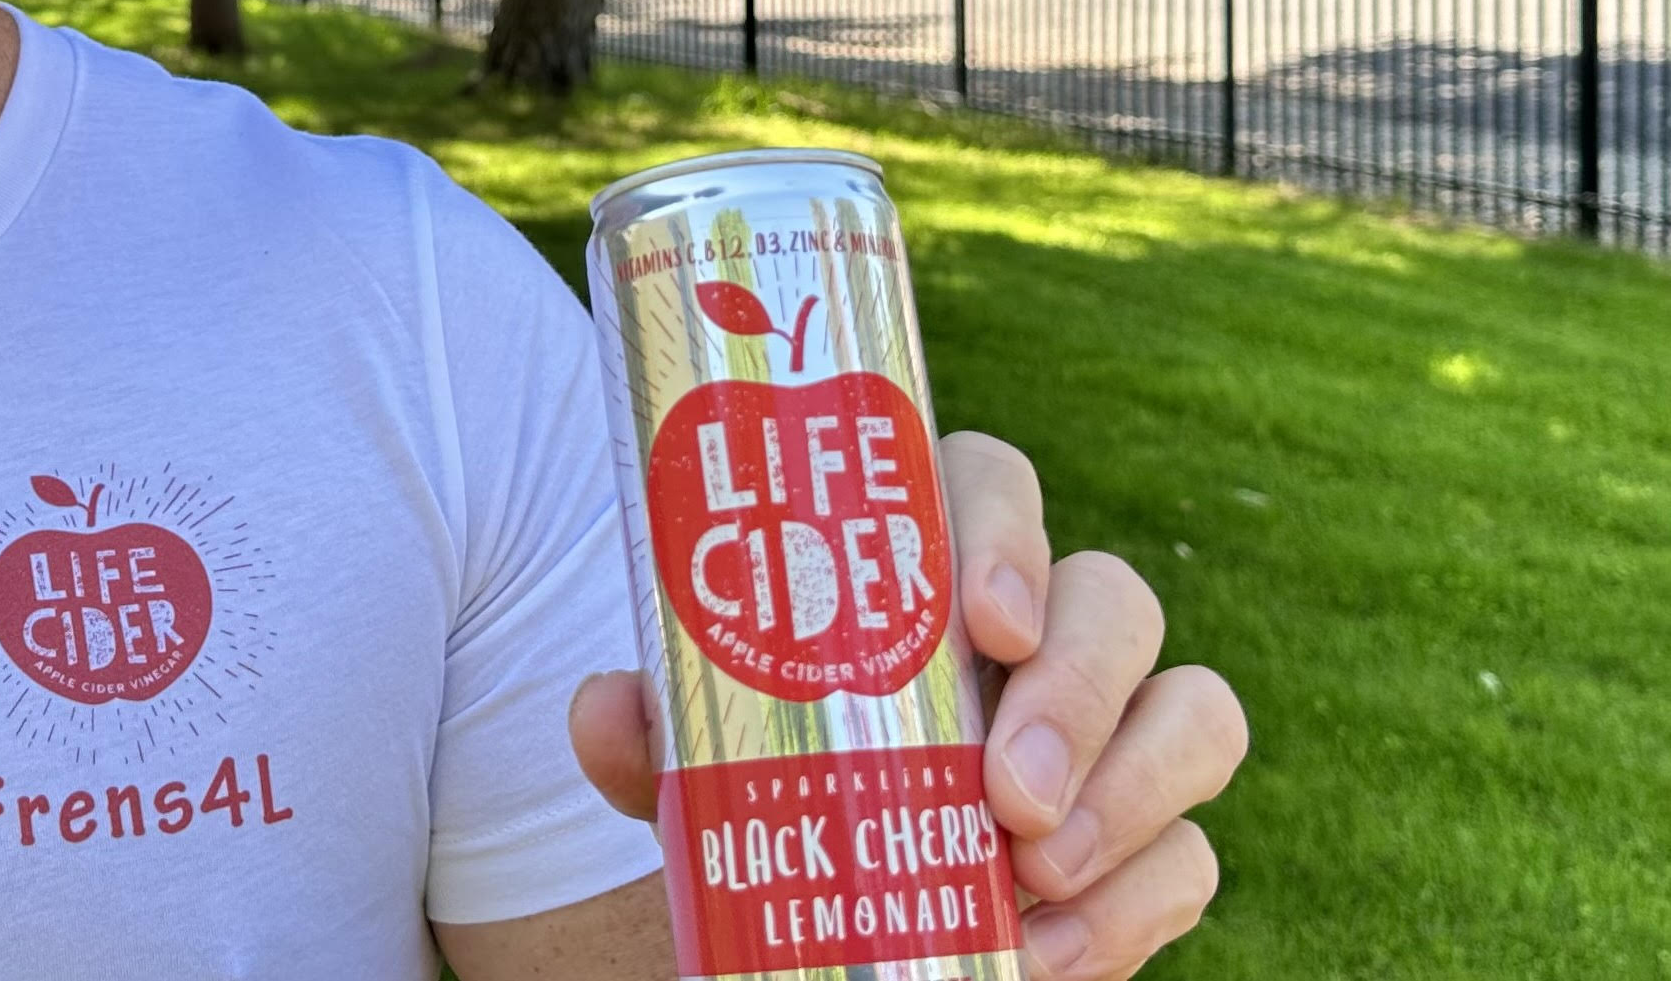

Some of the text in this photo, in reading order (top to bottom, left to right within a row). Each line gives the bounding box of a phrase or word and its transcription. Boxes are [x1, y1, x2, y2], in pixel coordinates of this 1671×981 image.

[617, 246, 682, 283] VITAMINS
[697, 415, 908, 513] LIFE
[30, 547, 165, 604] LIFE
[691, 514, 935, 640] CIDER
[23, 599, 184, 671] CIDER
[706, 608, 935, 683] APPLE CIDER VINEGAR
[34, 650, 184, 694] APPLE CIDER VINEGAR
[702, 799, 998, 891] BLACK CHERRY
[764, 885, 978, 946] LEMONADE
